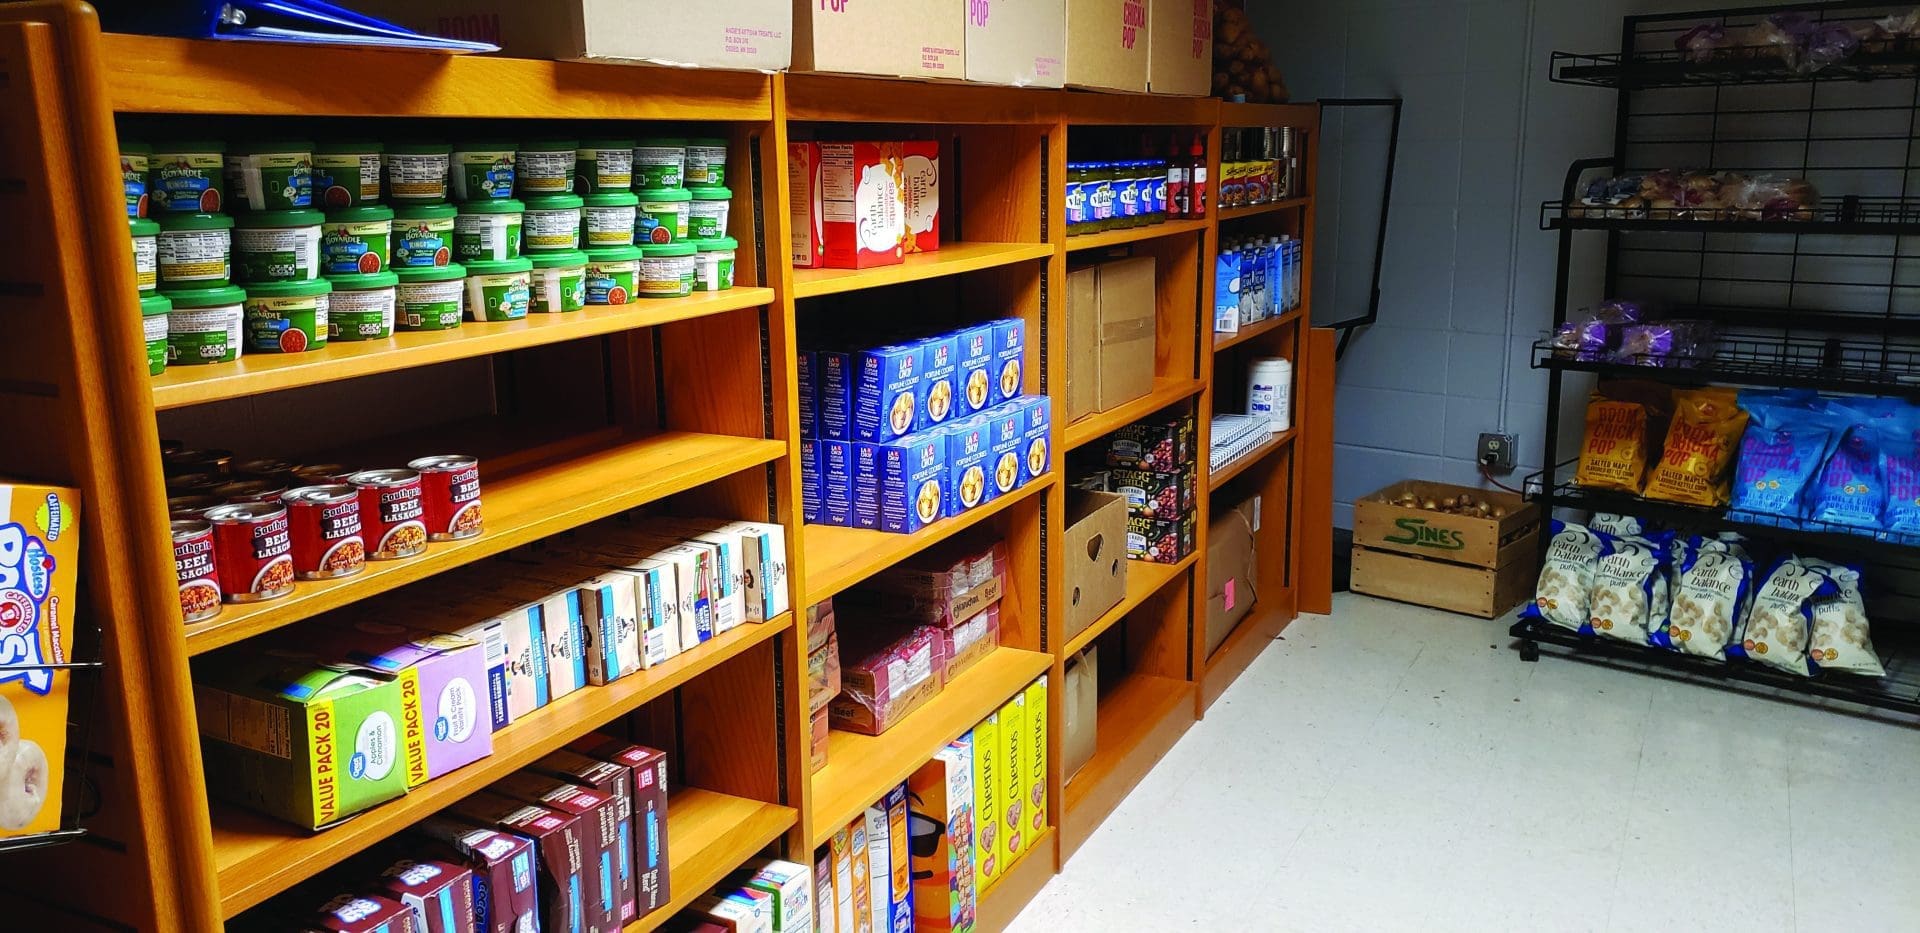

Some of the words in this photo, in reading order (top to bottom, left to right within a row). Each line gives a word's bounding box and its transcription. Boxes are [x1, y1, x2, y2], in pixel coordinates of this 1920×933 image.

[876, 184, 884, 229] balance
[1588, 439, 1616, 455] POP
[1591, 459, 1611, 469] SALTED
[1613, 461, 1632, 470] MAPLE
[1664, 450, 1690, 467] POP
[1113, 470, 1152, 482] STAGG
[1118, 479, 1144, 488] CHILI
[1662, 470, 1683, 480] SALTED
[1684, 473, 1705, 484] MAPLE
[392, 499, 419, 513] BEEF
[46, 492, 58, 542] CAFFEINATED
[333, 515, 359, 528] BEEF
[1383, 518, 1465, 550] SINES
[1553, 540, 1581, 553] earth
[175, 554, 207, 569] BEEF
[1553, 549, 1593, 566] balance
[26, 547, 44, 597] Hostess
[1559, 563, 1577, 572] puffs
[1602, 564, 1645, 578] balance
[1691, 566, 1718, 578] earth
[984, 583, 997, 598] Beef
[1610, 579, 1628, 588] puffs
[1690, 577, 1730, 593] balance
[1772, 575, 1799, 590] earth
[1695, 592, 1714, 601] puffs
[49, 596, 60, 628] Caramel
[1769, 602, 1788, 612] puffs
[1818, 605, 1840, 615] puffs
[524, 648, 532, 677] QUAKER
[402, 680, 415, 698] 20
[921, 680, 936, 694] Beef
[454, 686, 462, 705] Pack
[314, 711, 330, 731] 20
[405, 700, 419, 738] PACK
[834, 708, 856, 718] Beef
[1034, 711, 1042, 778] Cheerios
[316, 733, 332, 773] PACK
[408, 740, 424, 782] VALUE
[1009, 730, 1018, 798] Cheerios
[983, 749, 992, 821] Cheerios
[319, 777, 335, 822] VALUE
[599, 807, 608, 847] Sweetened
[642, 873, 651, 892] Blend
[650, 869, 658, 882] Oats
[477, 880, 488, 924] COCOA
[648, 889, 656, 909] Honey
